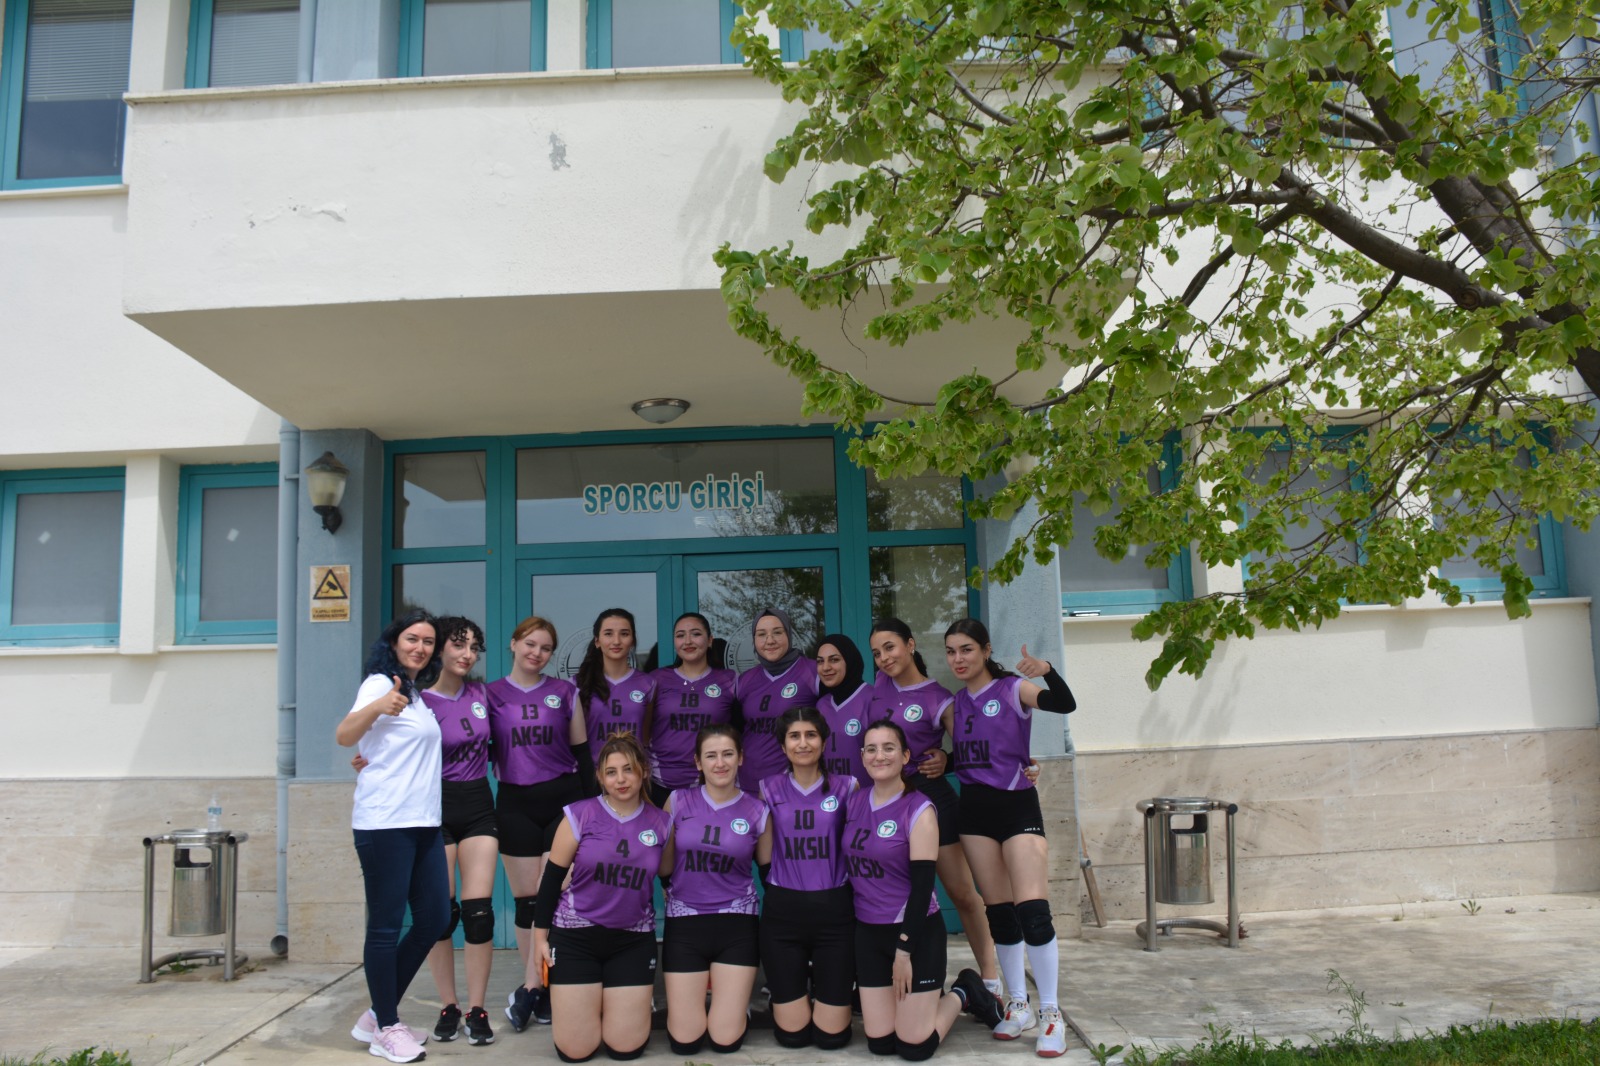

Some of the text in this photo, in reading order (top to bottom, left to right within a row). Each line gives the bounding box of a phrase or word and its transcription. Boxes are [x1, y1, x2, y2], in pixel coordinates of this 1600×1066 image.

[583, 471, 764, 515] SPORCU GİRİŞİ
[611, 699, 622, 716] 6
[680, 693, 699, 708] 18
[759, 695, 772, 712] 8
[521, 704, 539, 720] 13
[460, 717, 474, 737] 9
[670, 713, 711, 732] AKSU
[964, 715, 975, 735] 5
[511, 726, 553, 748] AKSU
[955, 740, 989, 764] AKSU
[825, 758, 850, 776] KSU
[794, 810, 814, 830] 10
[701, 825, 721, 846] 11
[850, 828, 871, 851] 12
[616, 839, 630, 858] 4
[784, 837, 829, 860] AKSU
[684, 850, 736, 874] AKSU
[844, 854, 884, 879] AKSU
[593, 862, 647, 890] AKSU
